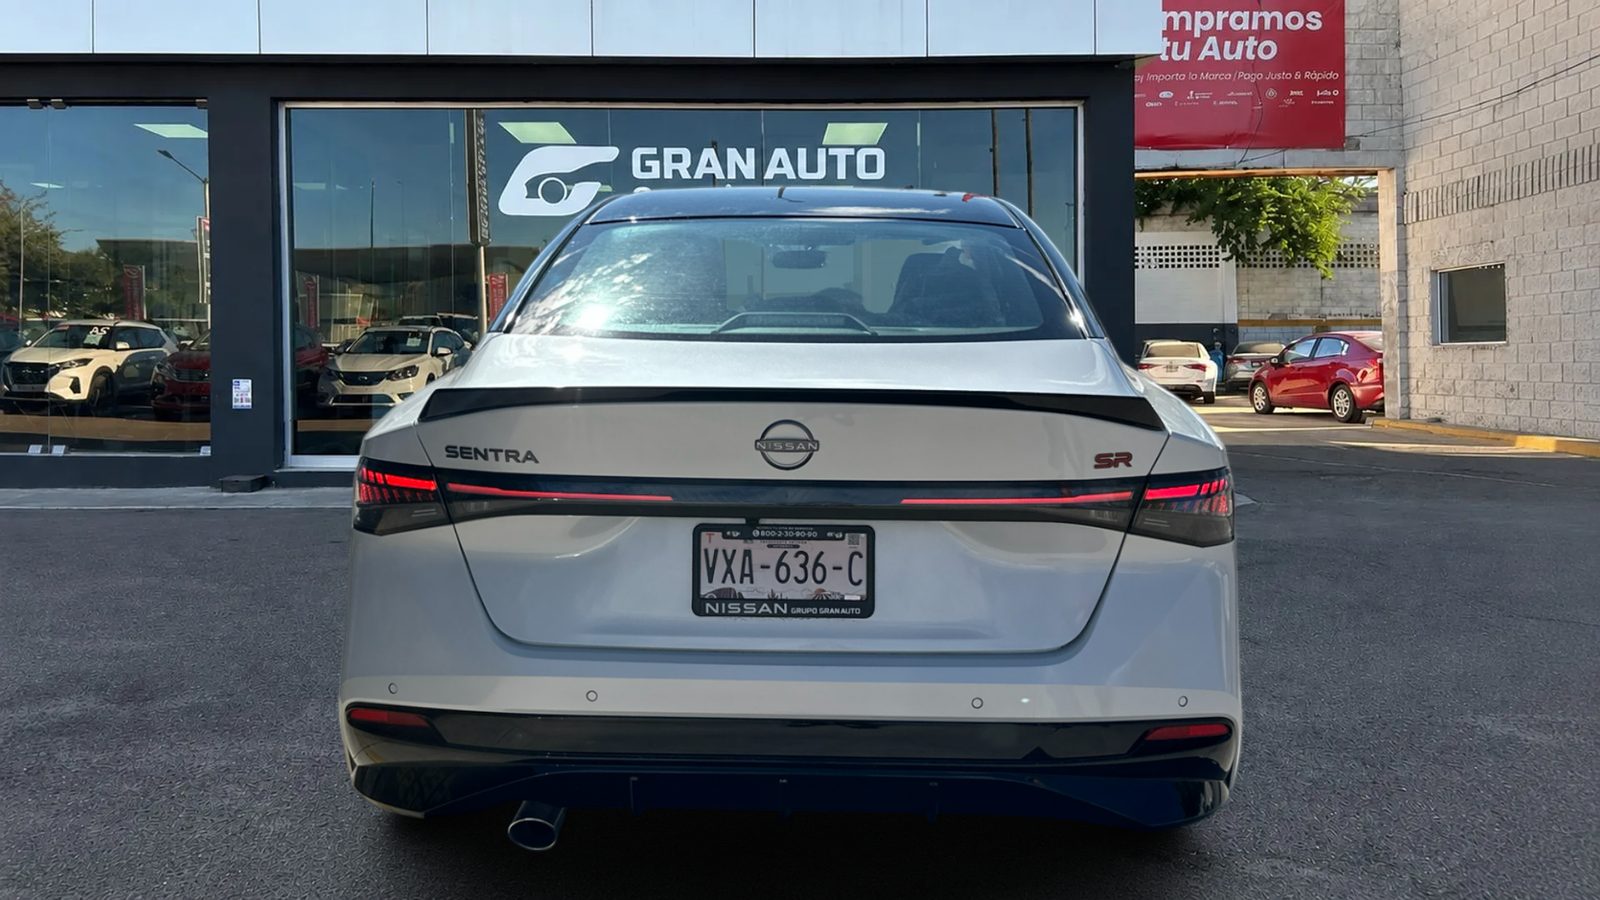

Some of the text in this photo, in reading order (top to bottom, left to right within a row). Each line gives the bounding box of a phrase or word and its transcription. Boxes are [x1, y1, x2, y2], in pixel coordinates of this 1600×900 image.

[1162, 10, 1322, 37] mpramos
[1160, 36, 1277, 61] tu Auto
[1199, 72, 1231, 80] Marca
[1265, 72, 1292, 80] Justo
[1294, 72, 1301, 80] &
[632, 147, 885, 180] GRAN AUTO
[445, 445, 540, 464] SENTRA
[756, 442, 818, 450] NISSAN
[1093, 452, 1133, 469] SR
[704, 548, 864, 586] VXA-636-C
[705, 602, 788, 614] NISSAN
[790, 607, 818, 615] GRUPO
